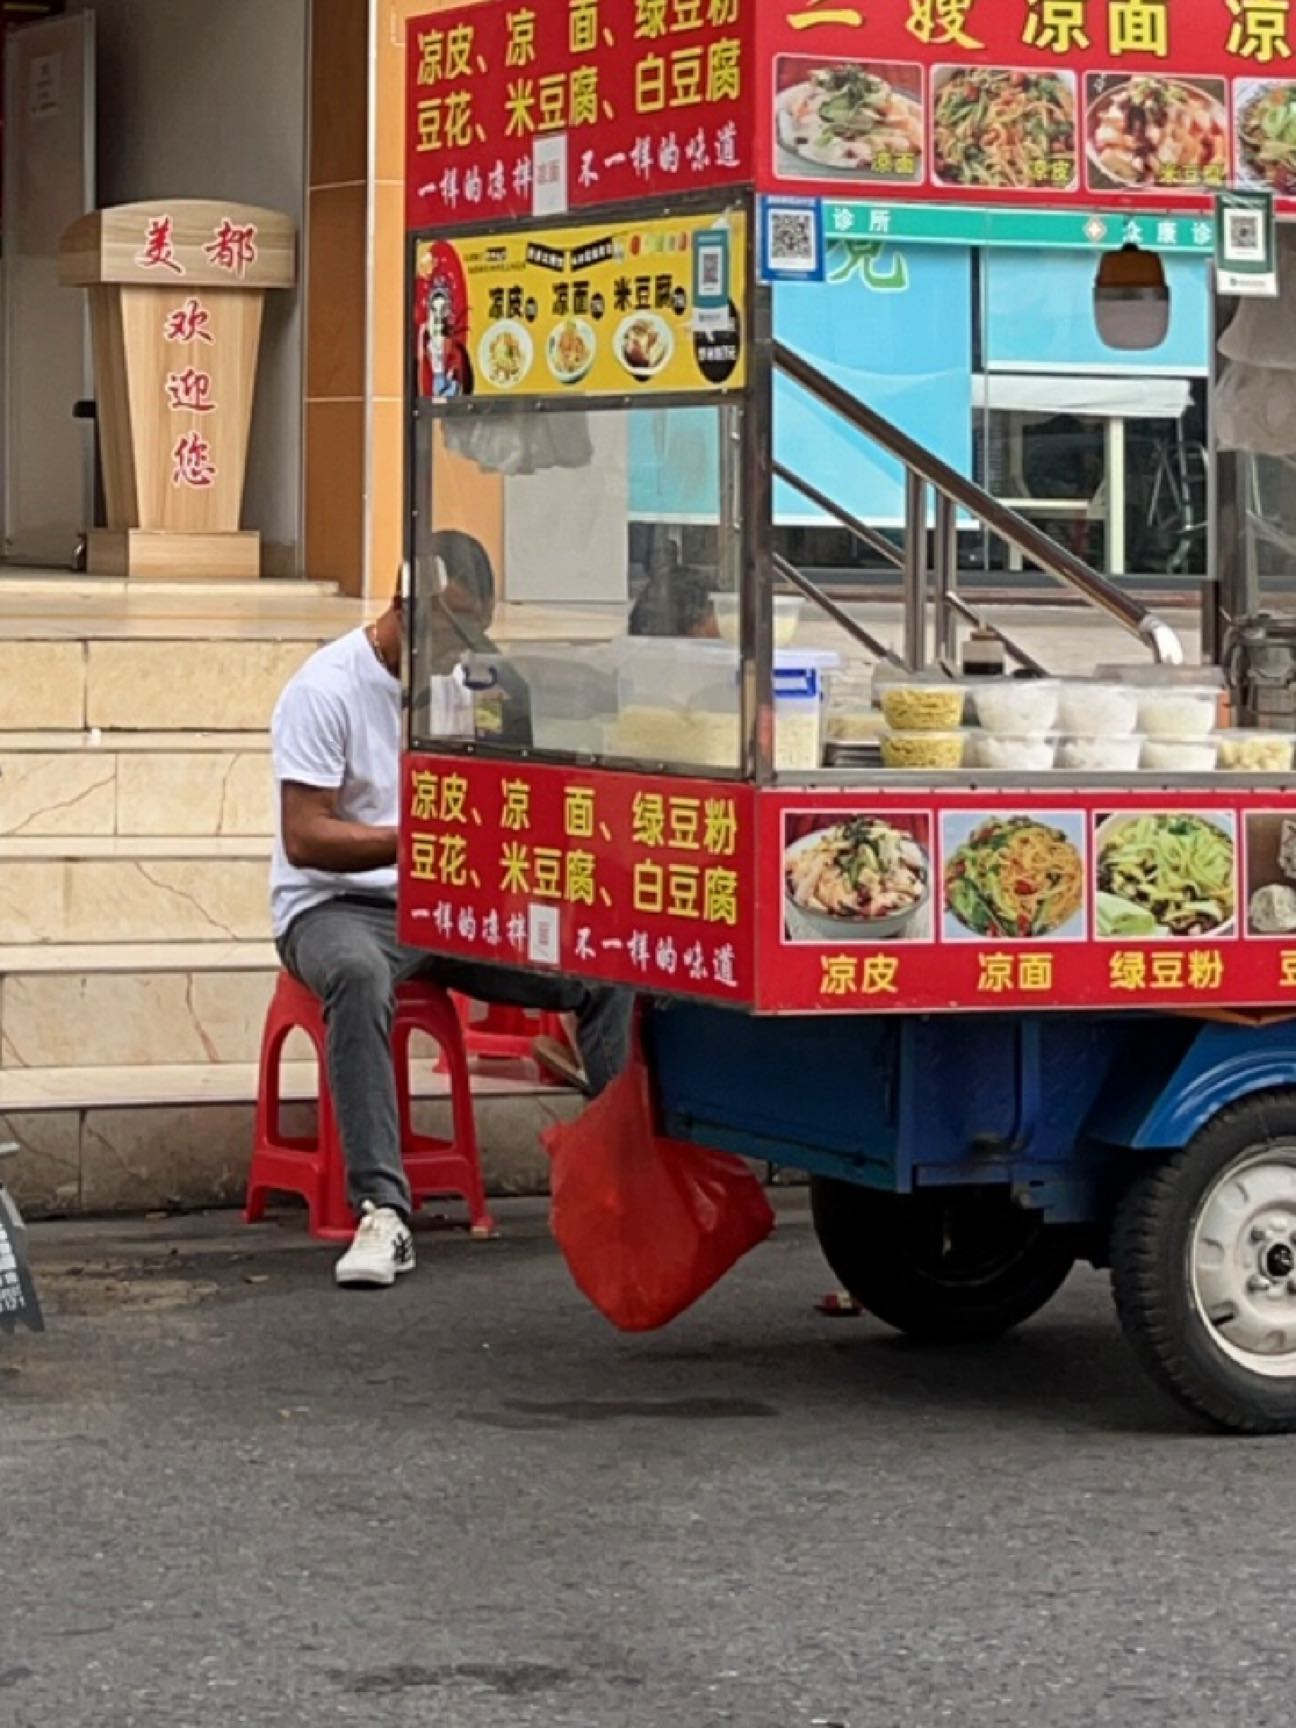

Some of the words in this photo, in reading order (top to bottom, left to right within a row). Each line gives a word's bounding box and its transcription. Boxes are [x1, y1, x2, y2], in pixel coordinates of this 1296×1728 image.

[164, 298, 220, 489] 欢迎您
[819, 953, 899, 995] 凉皮
[977, 953, 1054, 992] 凉面
[1109, 950, 1224, 990] 绿豆粉
